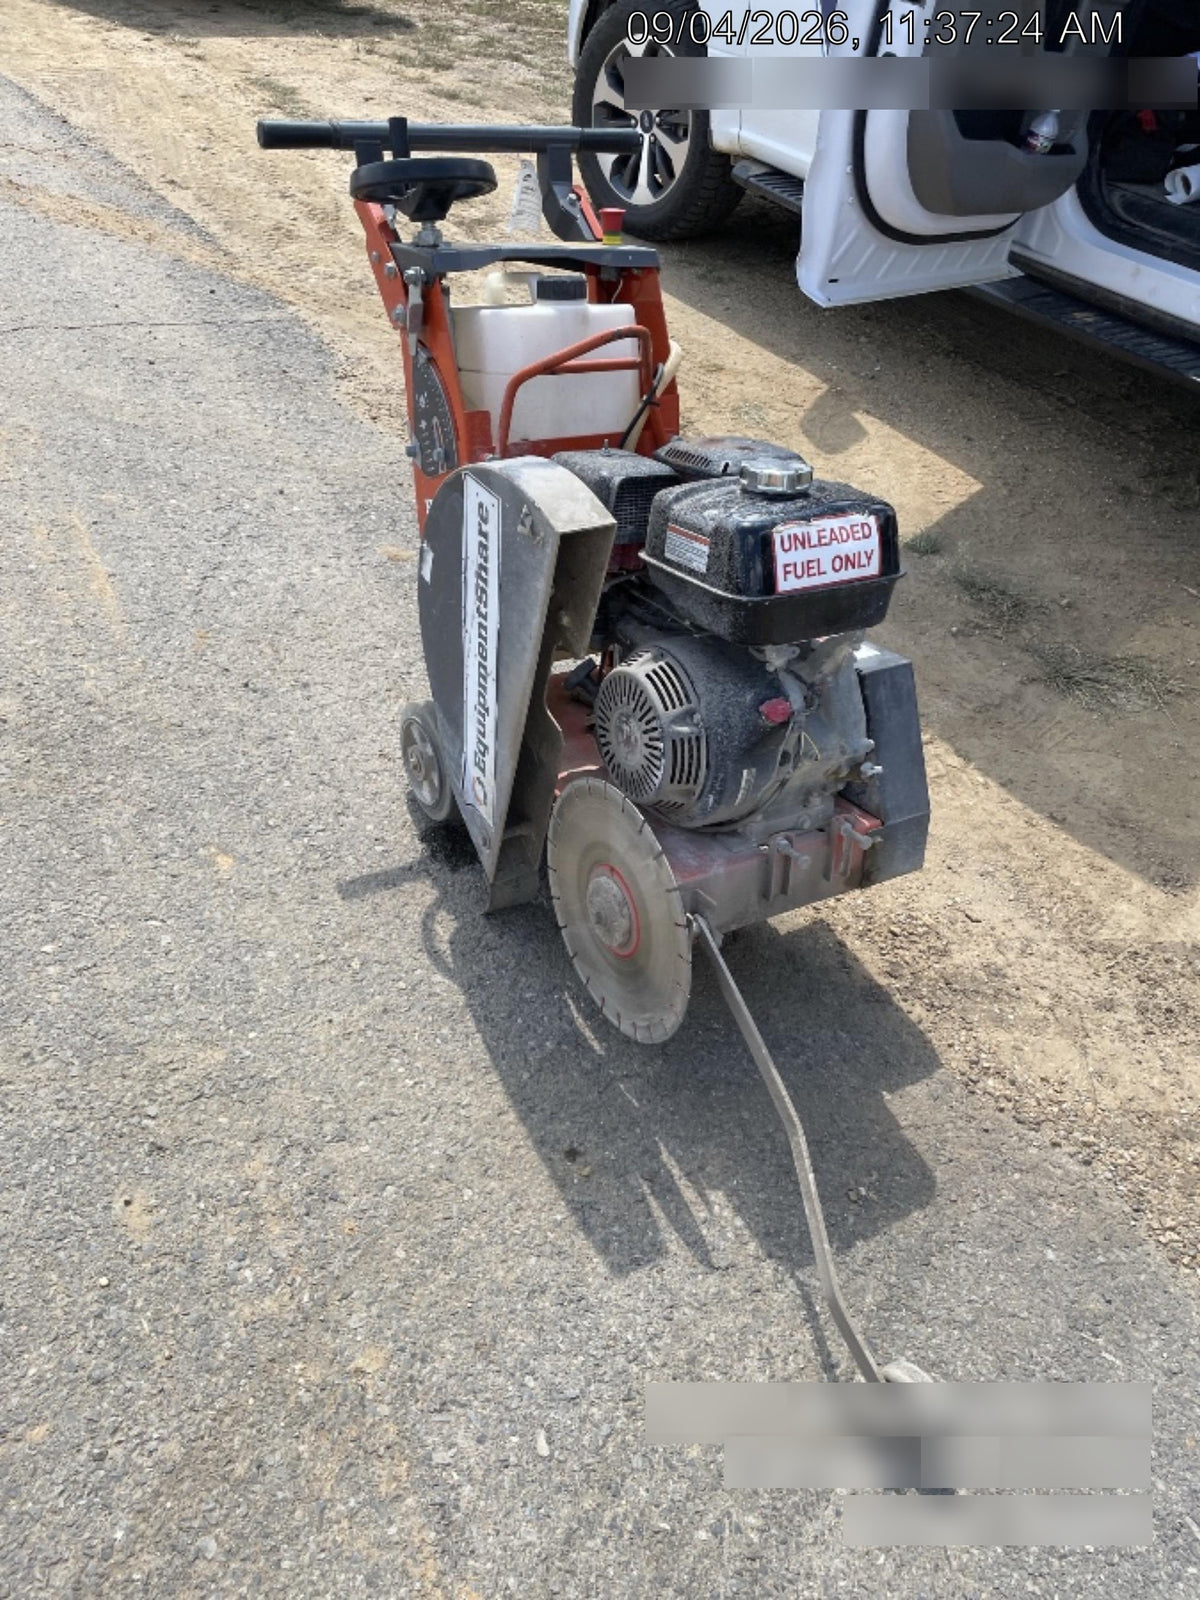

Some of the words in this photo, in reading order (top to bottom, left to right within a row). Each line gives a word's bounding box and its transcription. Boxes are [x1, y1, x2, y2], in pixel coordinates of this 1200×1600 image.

[780, 522, 872, 553] UNLEADED
[782, 557, 827, 582] FUEL
[831, 549, 874, 573] ONLY
[473, 501, 491, 778] EquipmentShare
